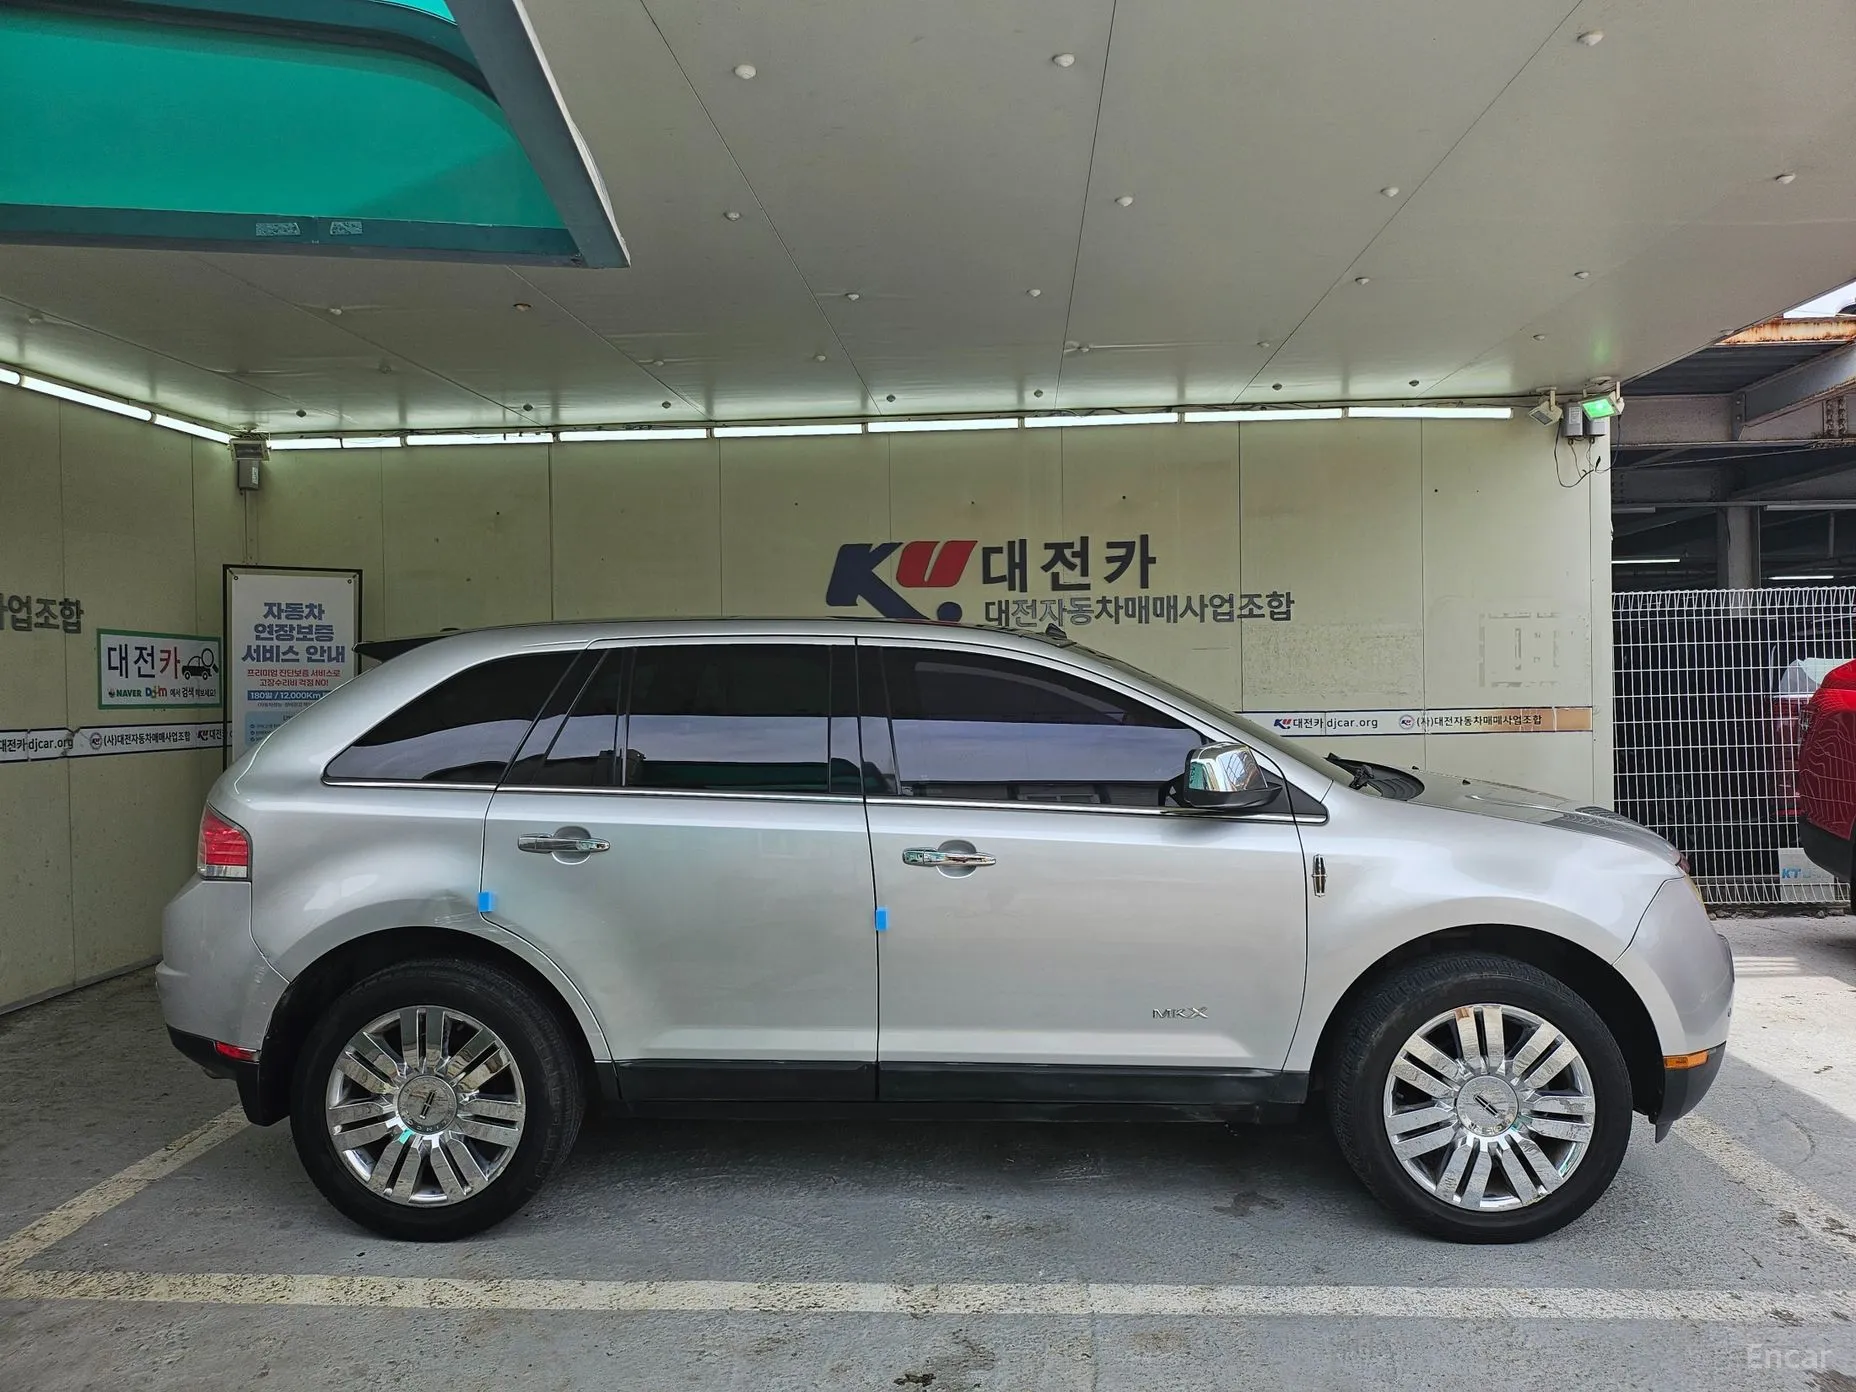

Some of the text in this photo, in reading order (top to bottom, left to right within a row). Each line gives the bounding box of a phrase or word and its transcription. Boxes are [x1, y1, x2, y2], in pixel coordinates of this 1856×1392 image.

[982, 534, 1157, 592] 대전카
[263, 602, 325, 621] 자동차
[985, 591, 1295, 628] 대전자동차매매사업조합
[254, 623, 335, 642] 연장보증
[107, 644, 181, 679] 대전카
[241, 645, 346, 663] 서비스 안내
[247, 669, 278, 677] 프리미엄
[311, 669, 341, 677] 서비스로
[259, 679, 298, 687] 고장수리비
[116, 689, 142, 698] NAVER
[181, 686, 194, 698] 검색
[1293, 718, 1324, 729] 대전카
[1326, 717, 1378, 730] djcar.org
[28, 738, 74, 752] djcar.org
[1152, 1006, 1209, 1019] MKX
